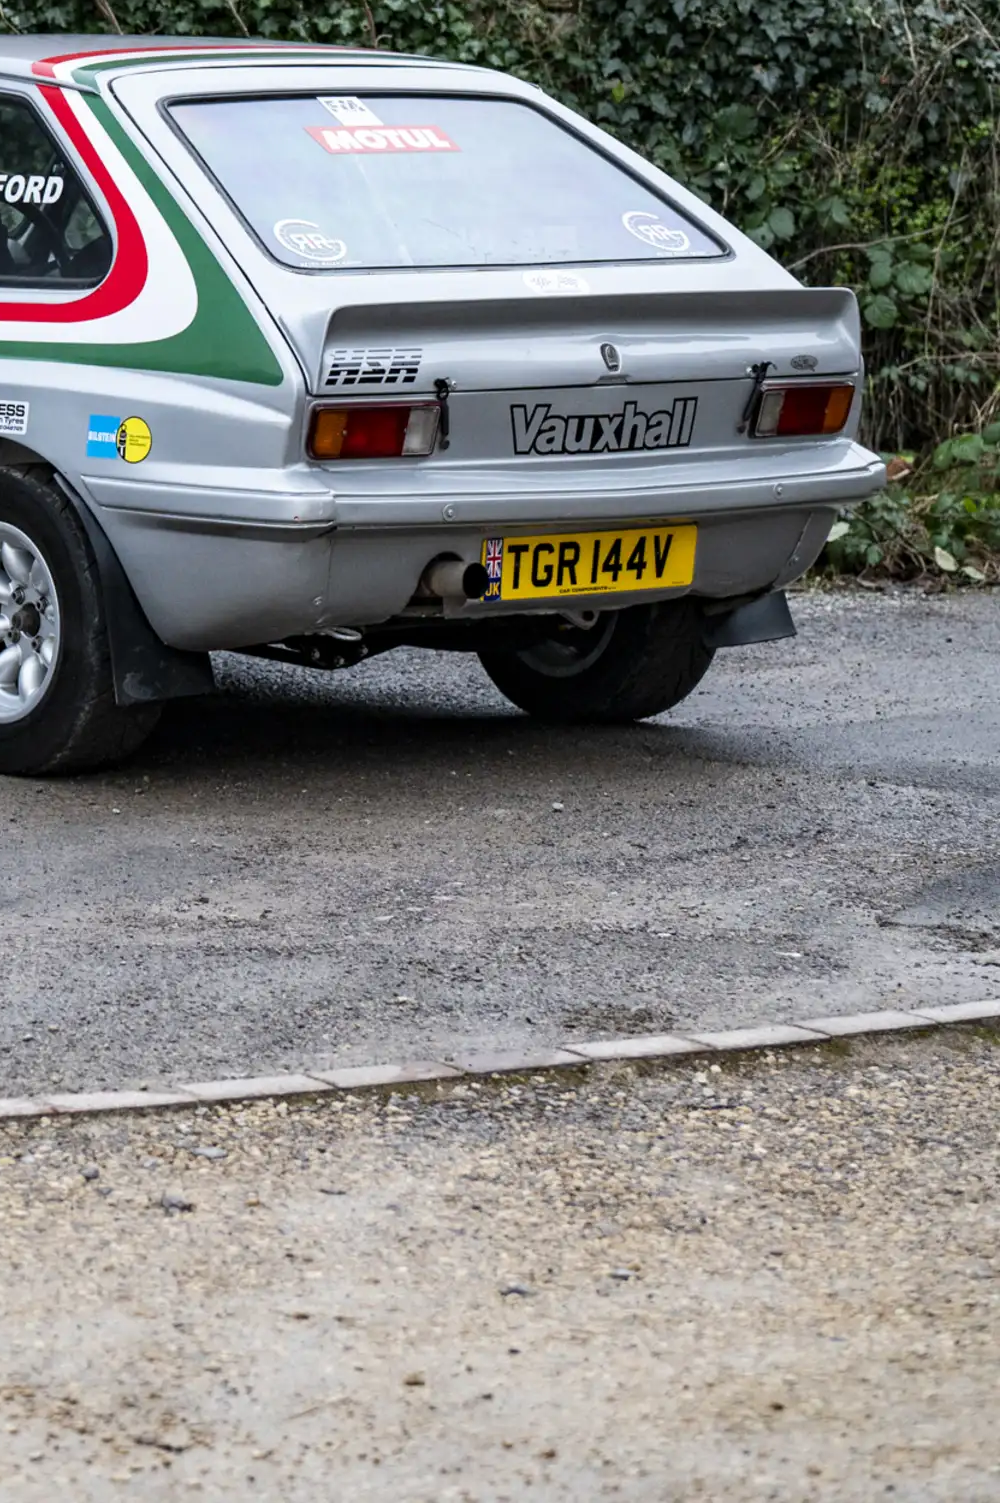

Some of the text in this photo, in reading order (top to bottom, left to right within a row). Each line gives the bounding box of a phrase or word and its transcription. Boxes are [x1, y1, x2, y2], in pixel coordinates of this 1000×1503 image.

[320, 128, 451, 150] MOTUL
[4, 417, 24, 425] Tyres
[510, 396, 698, 455] Vauxhall
[507, 534, 674, 589] TGR 144V
